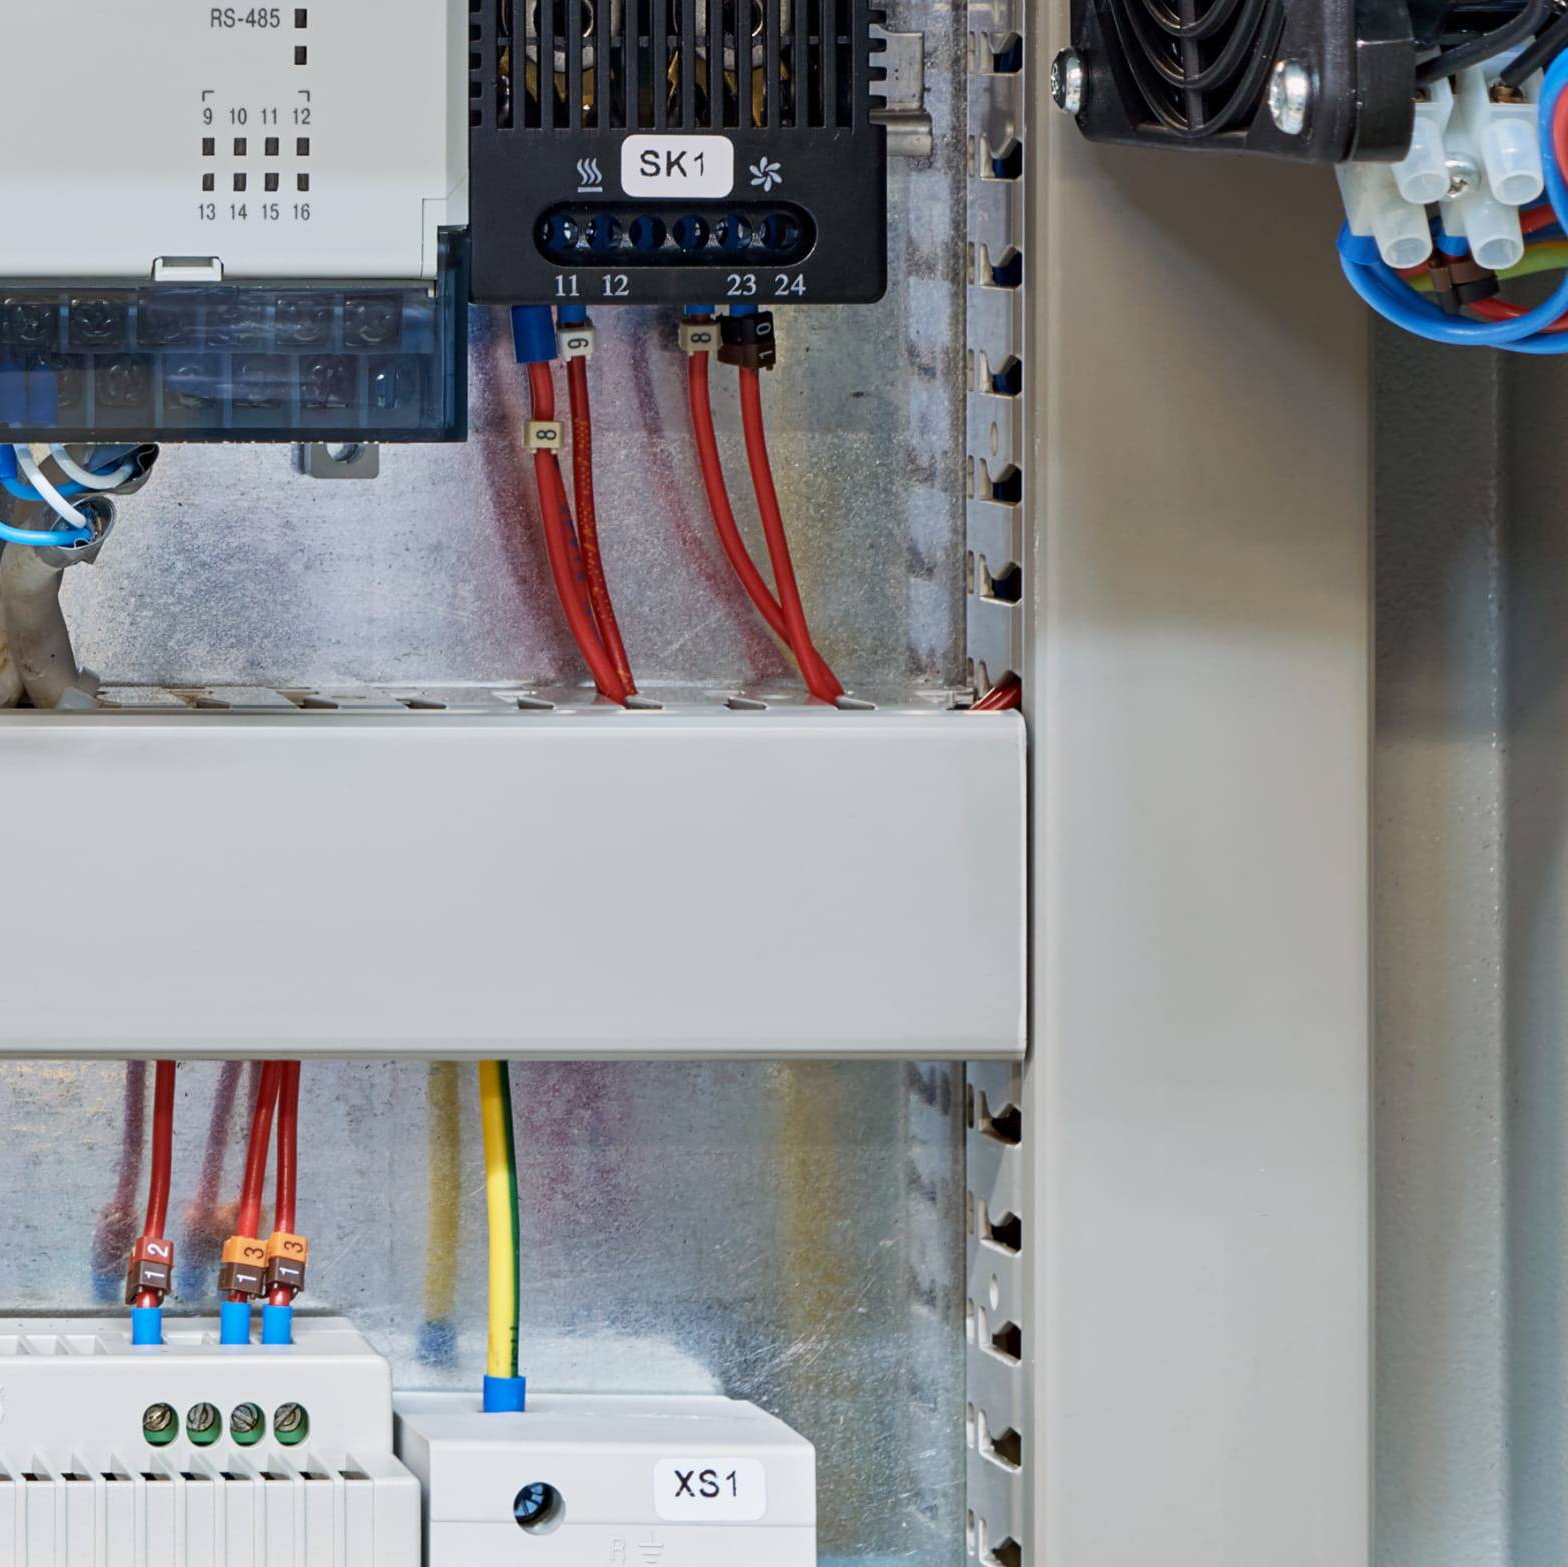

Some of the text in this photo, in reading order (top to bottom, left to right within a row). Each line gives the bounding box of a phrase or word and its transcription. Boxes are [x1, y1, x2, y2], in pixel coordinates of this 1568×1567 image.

[210, 8, 281, 28] RS-485
[203, 108, 311, 125] 9 10 11 12
[639, 149, 705, 178] SK1
[198, 203, 311, 221] 13 14 15 16
[555, 275, 806, 296] 11 12 23 24
[673, 1469, 739, 1498] XS1
